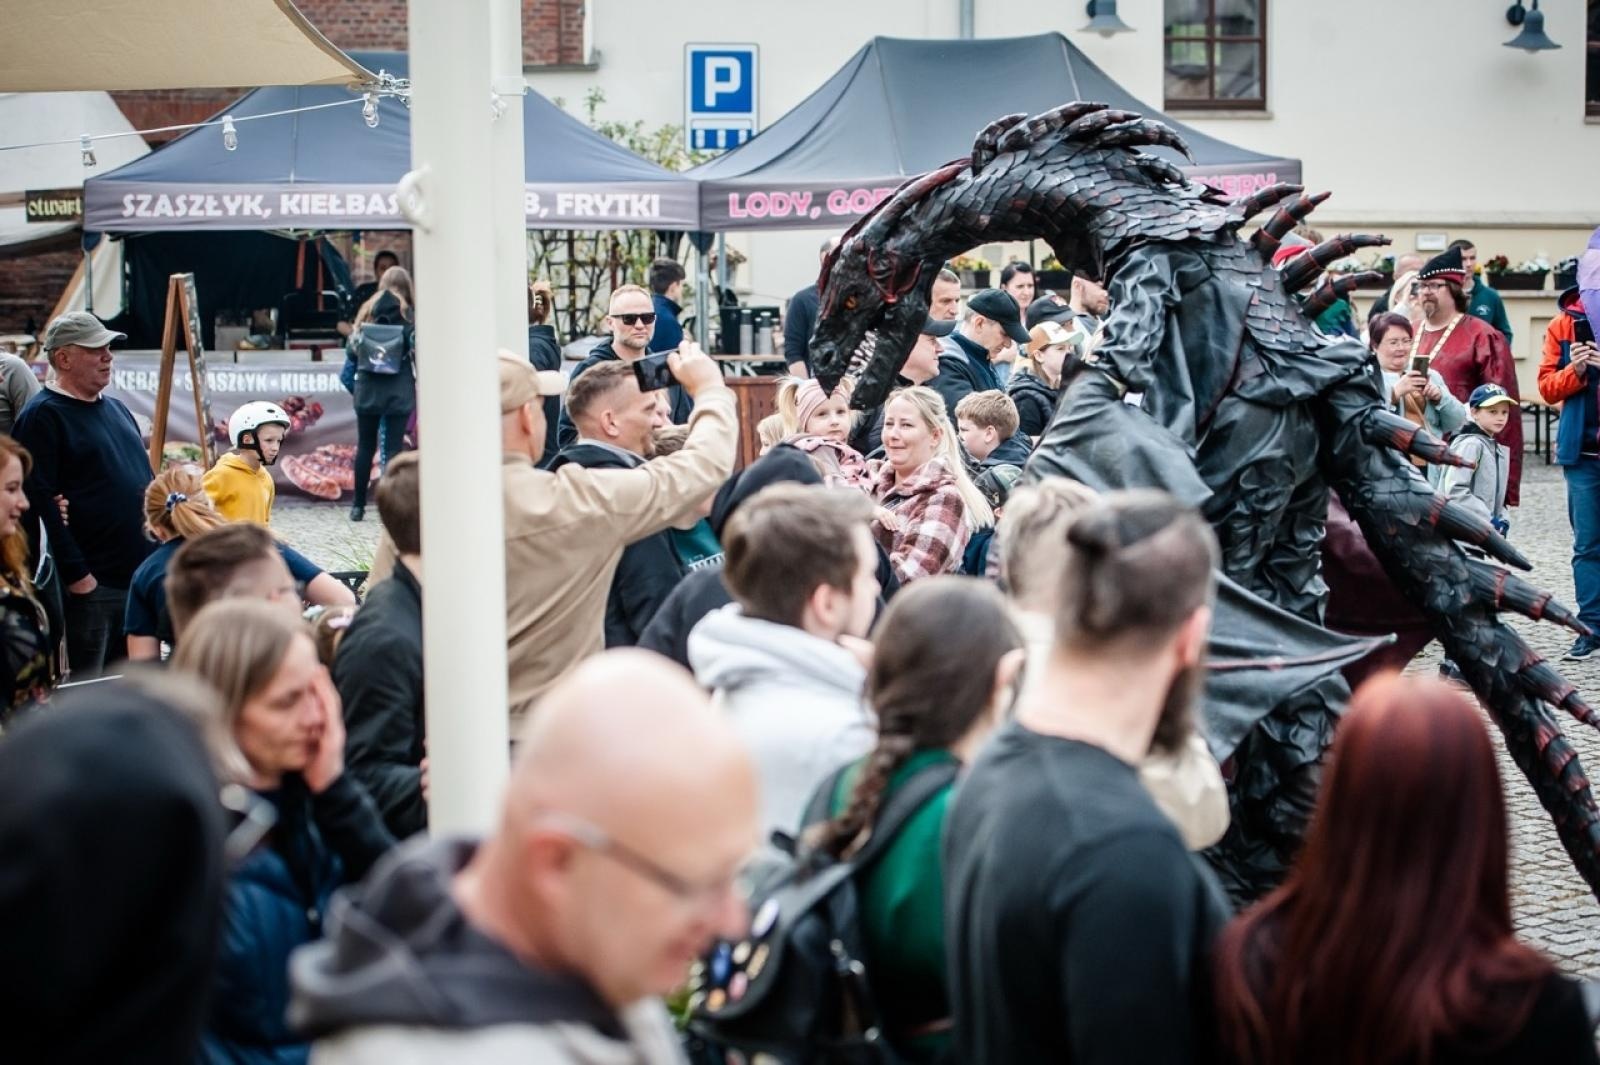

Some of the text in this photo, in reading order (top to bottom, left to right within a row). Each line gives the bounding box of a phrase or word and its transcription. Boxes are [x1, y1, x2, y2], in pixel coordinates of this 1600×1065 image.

[704, 56, 741, 107] P
[121, 193, 272, 218] SZASZŁYK,
[279, 192, 401, 216] KIEŁBAS
[556, 193, 661, 217] FRYTKI
[728, 191, 822, 219] LODY,
[113, 369, 160, 391] KEBA
[184, 370, 268, 392] SASZŁYK
